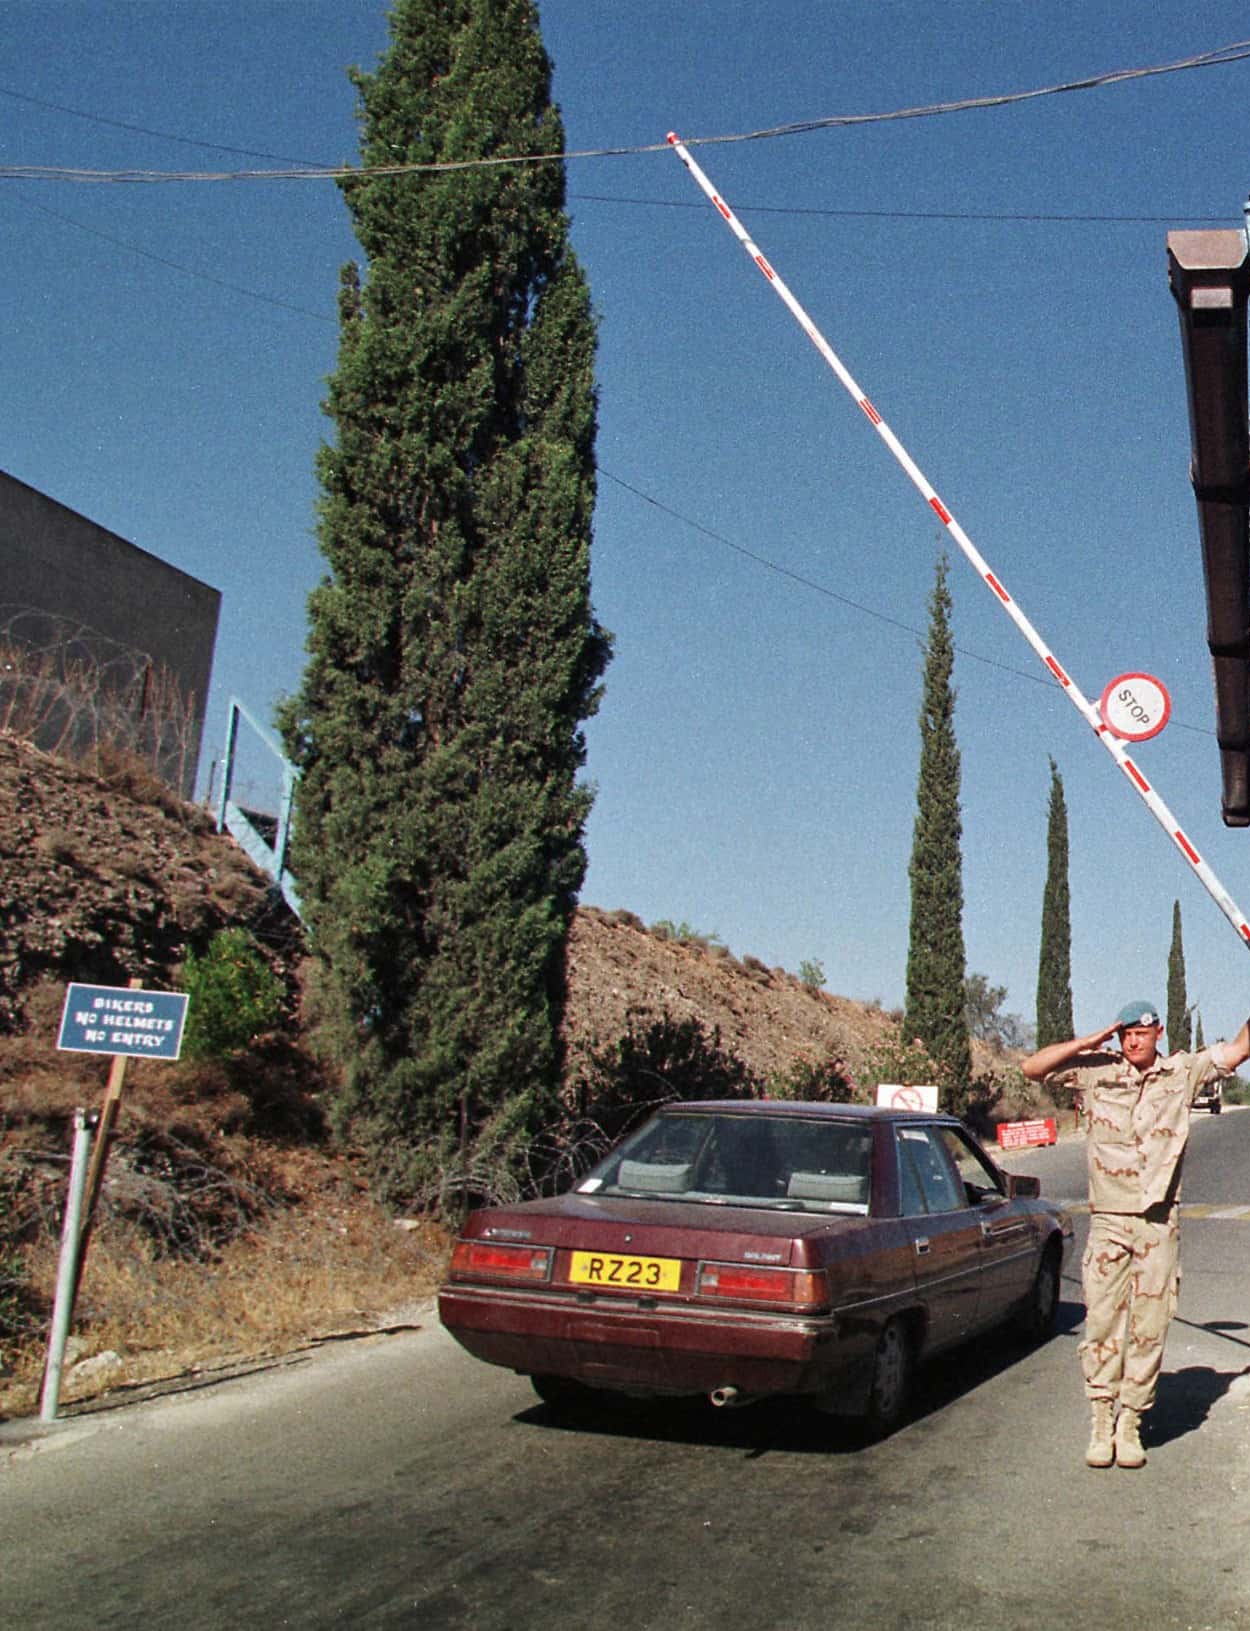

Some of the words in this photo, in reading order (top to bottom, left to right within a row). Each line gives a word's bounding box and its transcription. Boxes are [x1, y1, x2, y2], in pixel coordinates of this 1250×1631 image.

[1118, 688, 1151, 724] STOP
[93, 997, 155, 1014] BIKERS
[75, 1011, 98, 1026] NO
[102, 1014, 175, 1031] HELMETS
[84, 1029, 106, 1043] NO
[111, 1031, 165, 1047] ENTRY
[588, 1257, 662, 1286] RZ23
